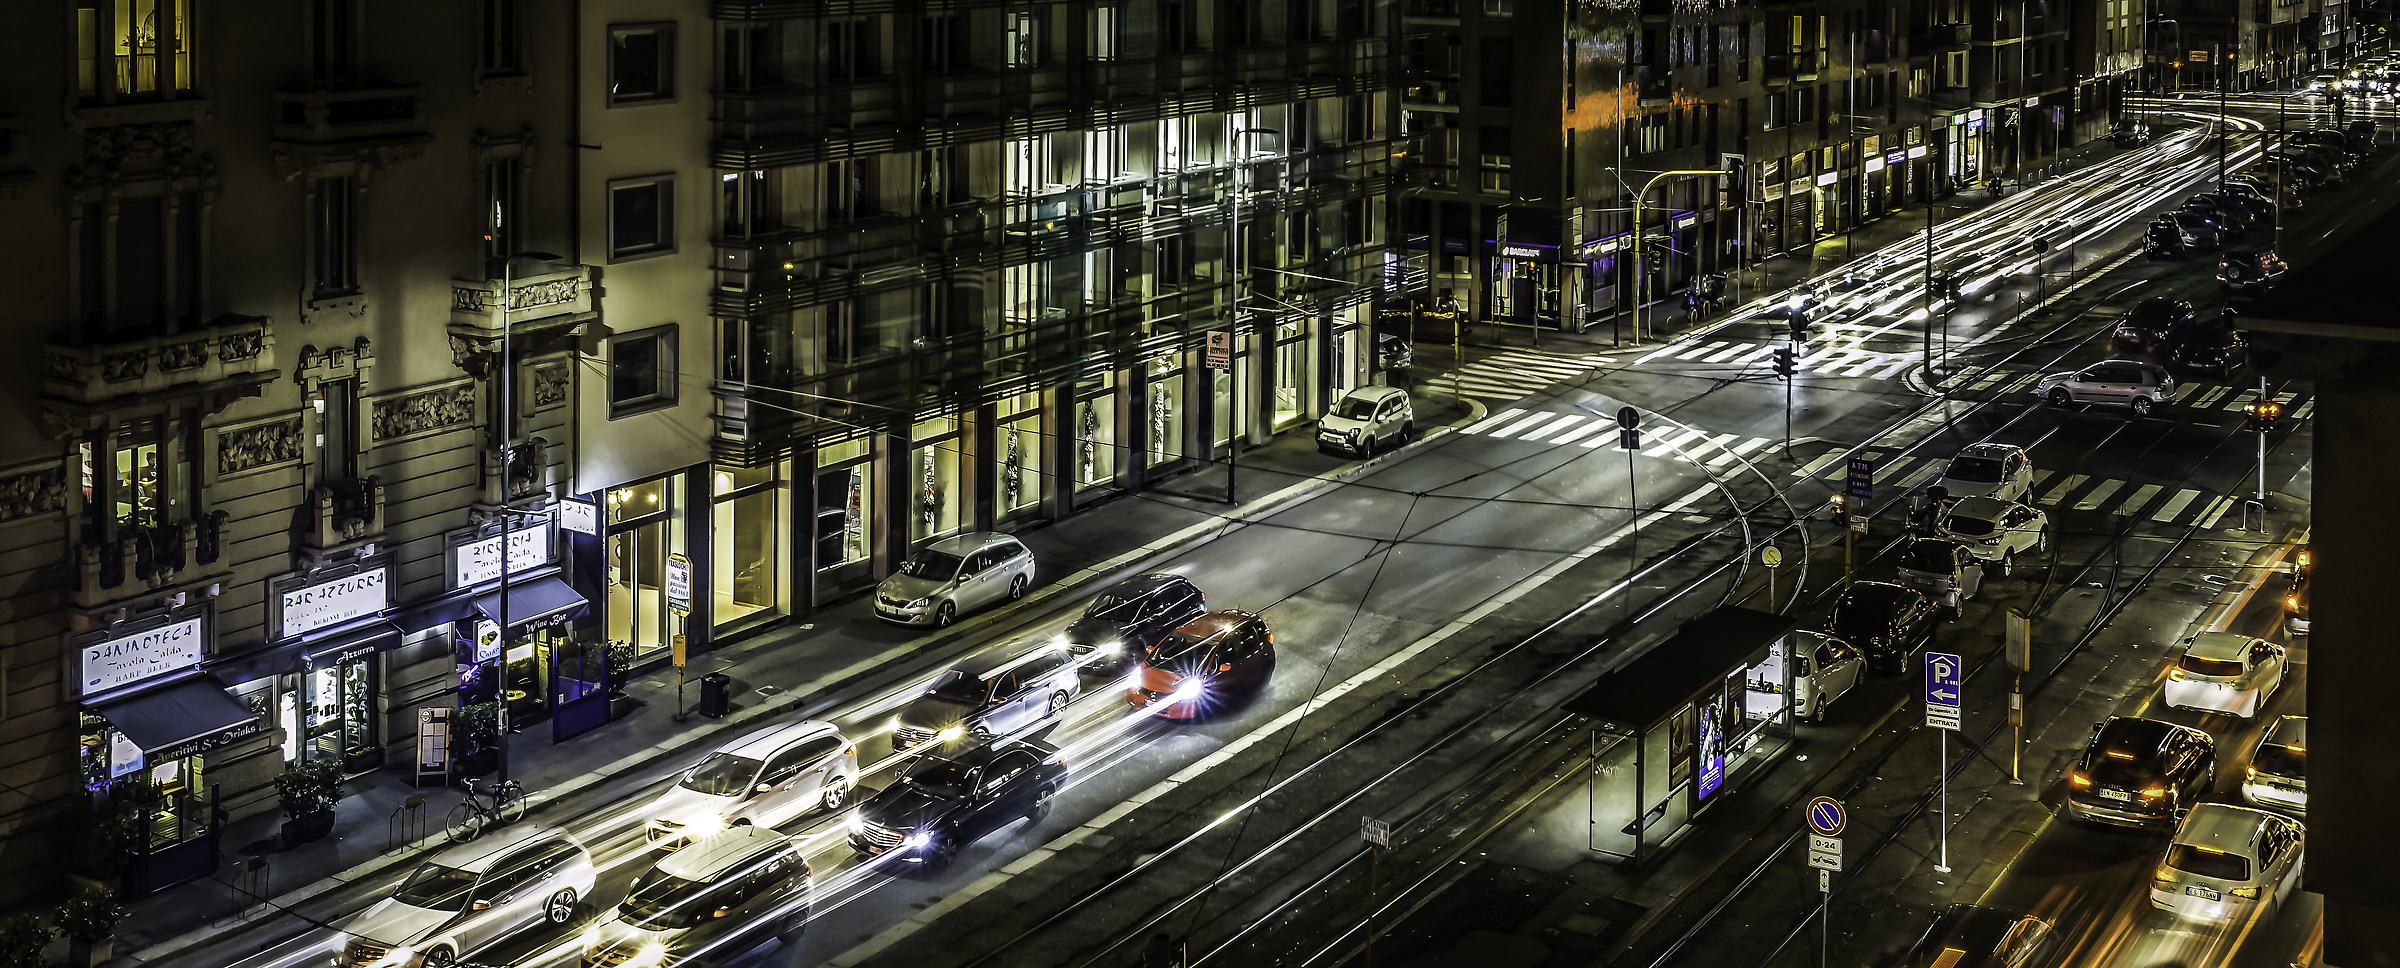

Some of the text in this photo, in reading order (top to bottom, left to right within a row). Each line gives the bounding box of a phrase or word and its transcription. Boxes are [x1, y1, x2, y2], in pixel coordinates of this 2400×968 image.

[285, 571, 384, 609] BAR AZZURRA
[525, 613, 568, 635] Wine Bar
[91, 624, 193, 665] PANINOTECA
[335, 645, 375, 666] Azzurra
[1934, 662, 1952, 684] P
[1929, 718, 1958, 728] ENTRATA
[150, 741, 199, 768] Aperitivi
[219, 724, 257, 745] Drinks
[1815, 839, 1836, 850] 0-24
